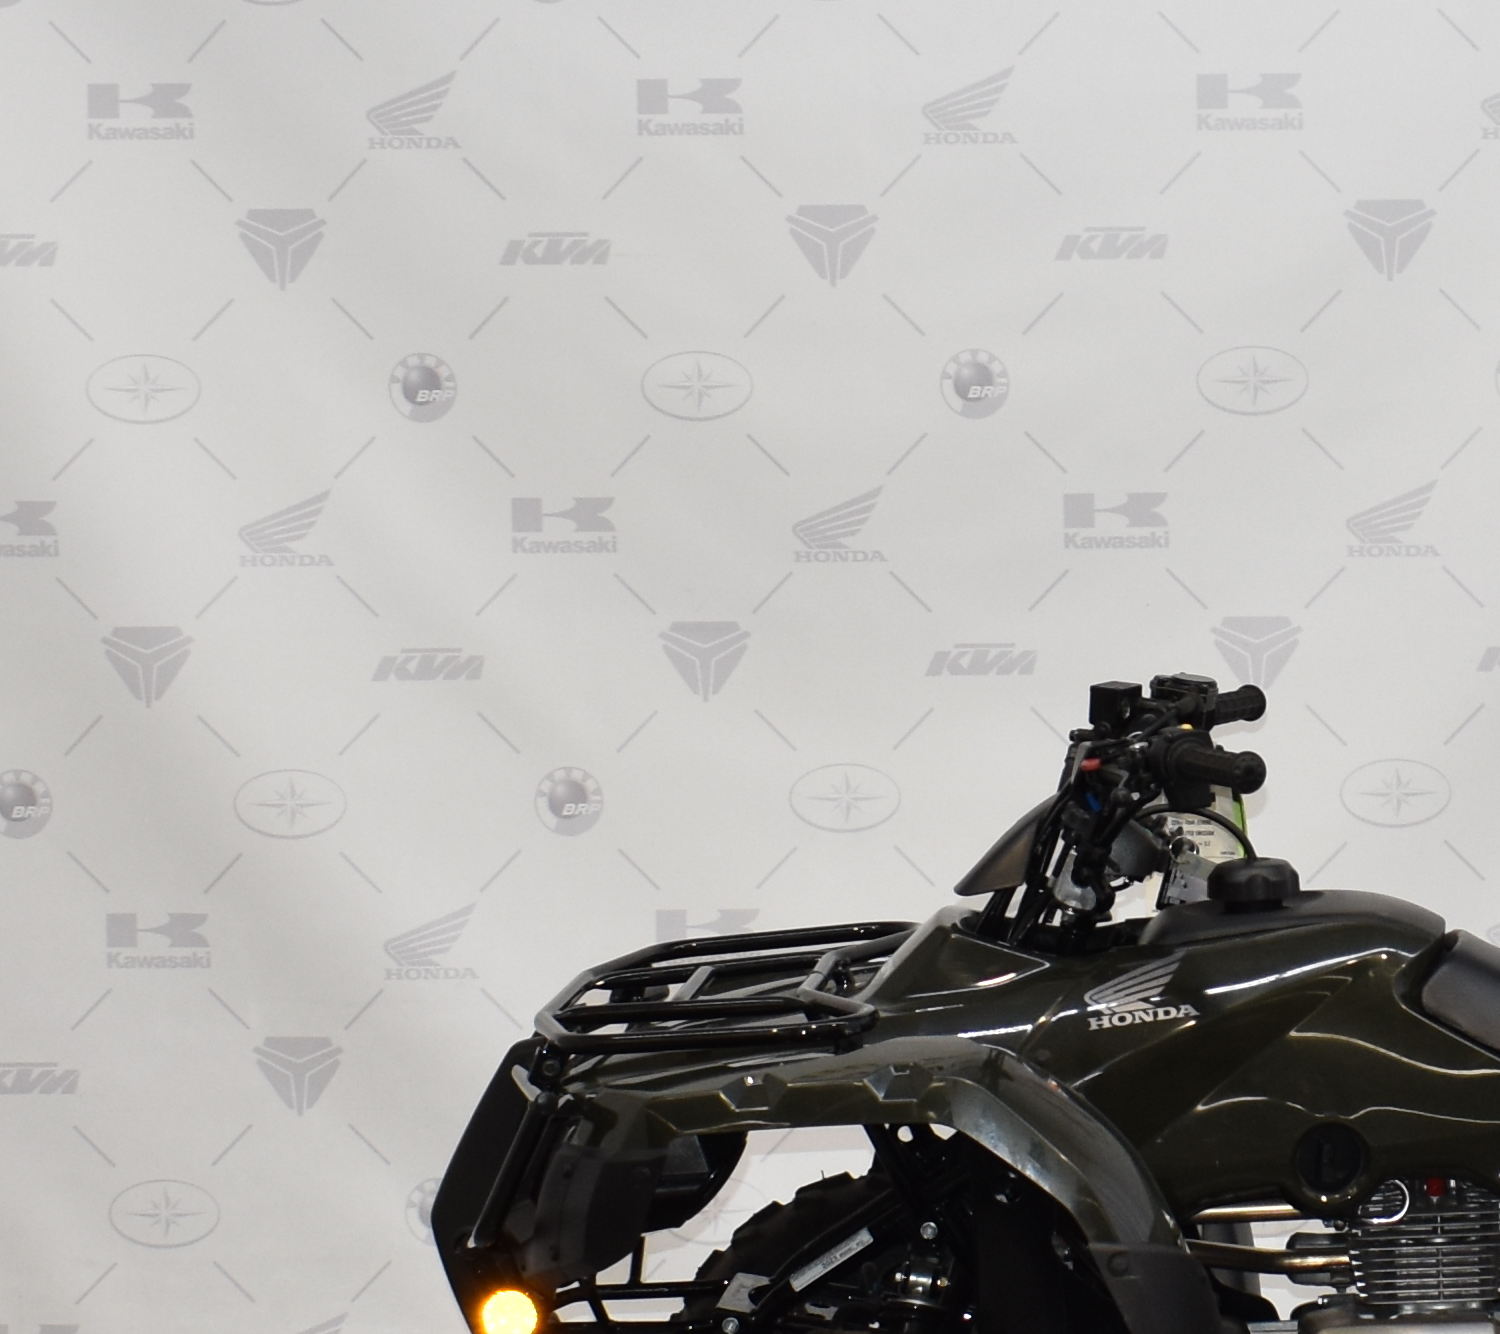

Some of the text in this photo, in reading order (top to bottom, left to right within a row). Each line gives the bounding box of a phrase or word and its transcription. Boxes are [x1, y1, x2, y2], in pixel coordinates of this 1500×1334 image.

[86, 120, 196, 143] Kawasaki
[636, 116, 744, 138] Kawasaki
[1195, 111, 1303, 133] Kawasaki
[368, 135, 462, 150] HONDA
[922, 130, 1019, 146] HONDA
[498, 231, 612, 267] KTM
[1053, 225, 1170, 261] KTM
[415, 388, 456, 404] BRP
[509, 534, 619, 556] Kawasaki
[1062, 530, 1170, 551] Kawasaki
[1347, 543, 1441, 558] HONDA
[239, 553, 336, 567] HONDA
[792, 549, 889, 563] HONDA
[372, 647, 486, 681] KTM
[924, 643, 1038, 677] KTM
[10, 805, 52, 820] BRP
[561, 802, 602, 817] BRP
[106, 949, 212, 971] Kawasaki
[383, 965, 480, 982] HONDA
[1086, 1003, 1201, 1031] HONDA
